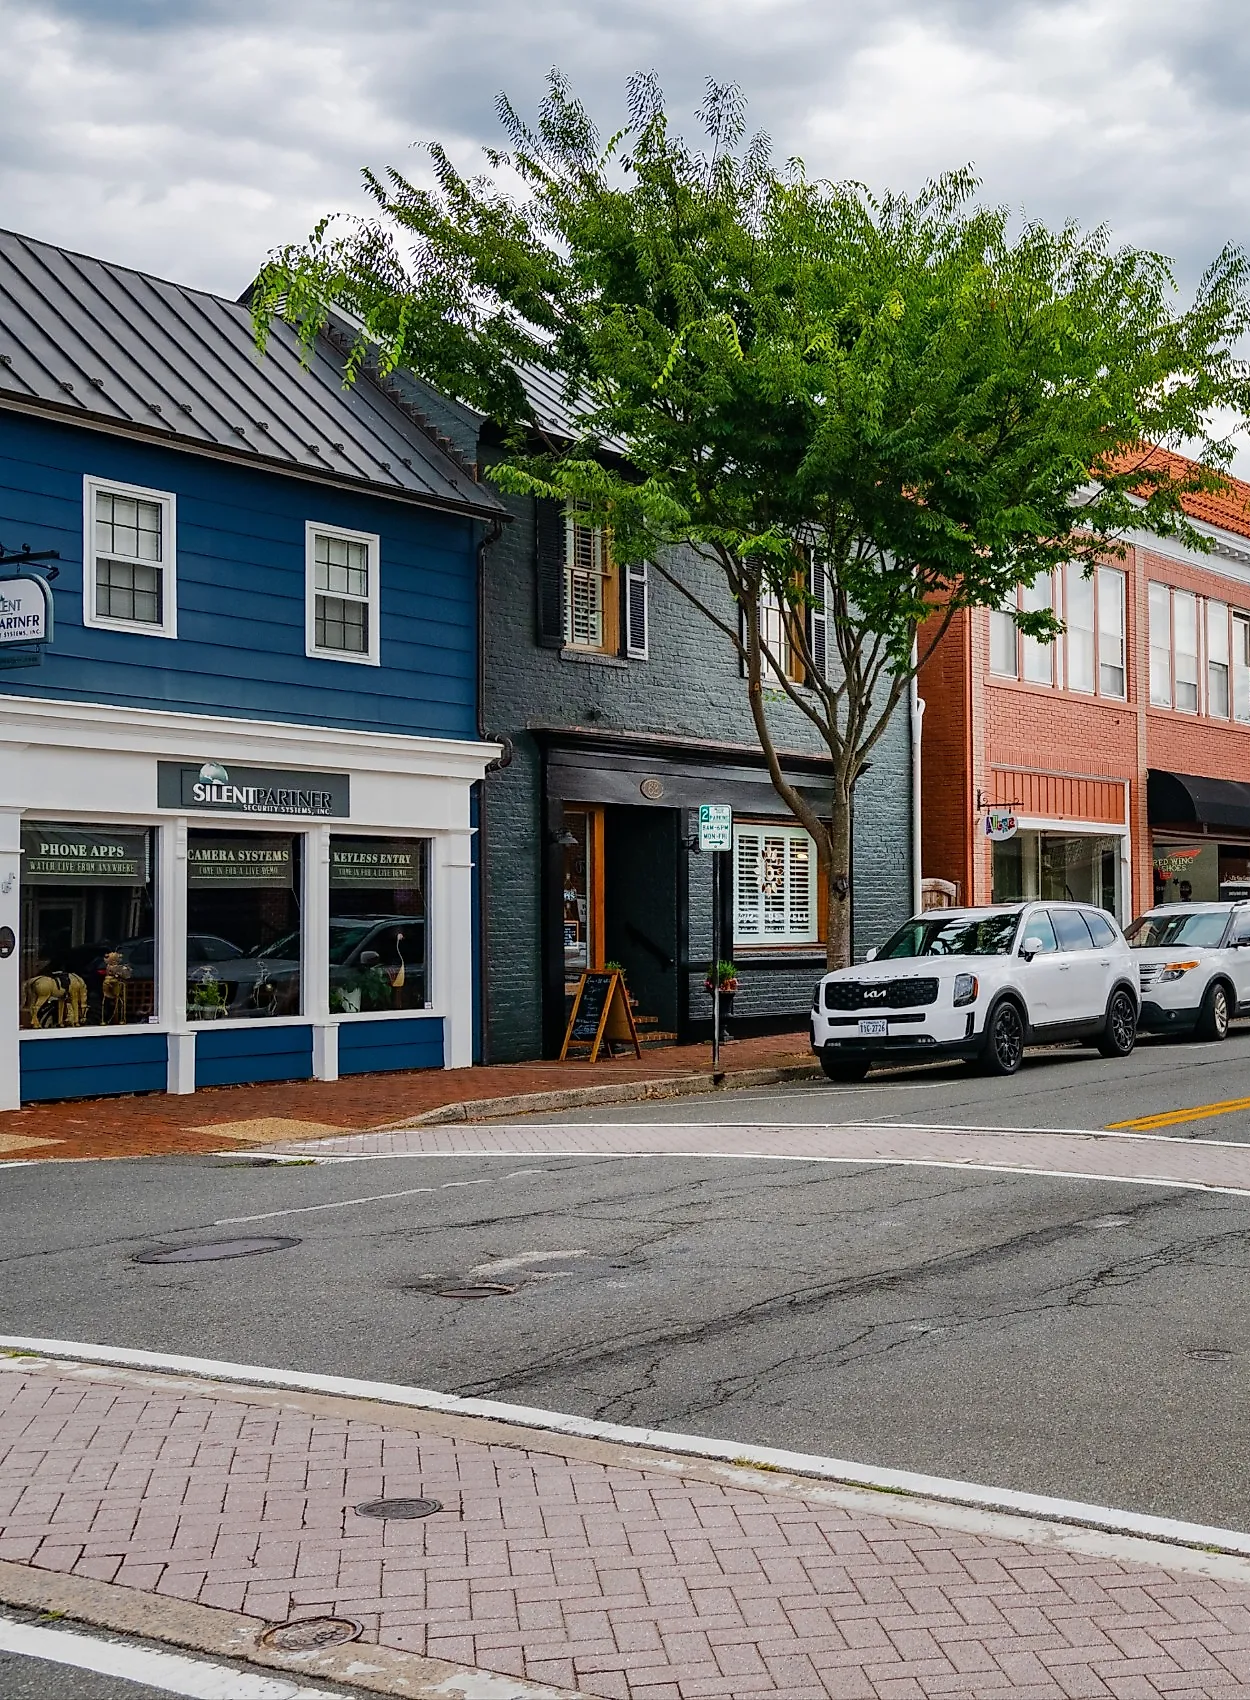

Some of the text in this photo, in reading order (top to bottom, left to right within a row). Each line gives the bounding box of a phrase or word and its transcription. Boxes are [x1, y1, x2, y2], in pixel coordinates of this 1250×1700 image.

[243, 804, 278, 813] SECURITY
[280, 806, 314, 816] SYSTEMS,
[702, 808, 709, 820] 2
[40, 843, 124, 858] PHONE APPS
[187, 849, 289, 861] CAMERA SYSTEMS
[333, 851, 412, 864] KEYLESS ENTRY
[1153, 856, 1194, 867] RED WING
[29, 861, 135, 873] WATCH LIVE FROM ANYWHERE
[245, 866, 260, 875] LIVE
[1161, 864, 1187, 872] SHOES
